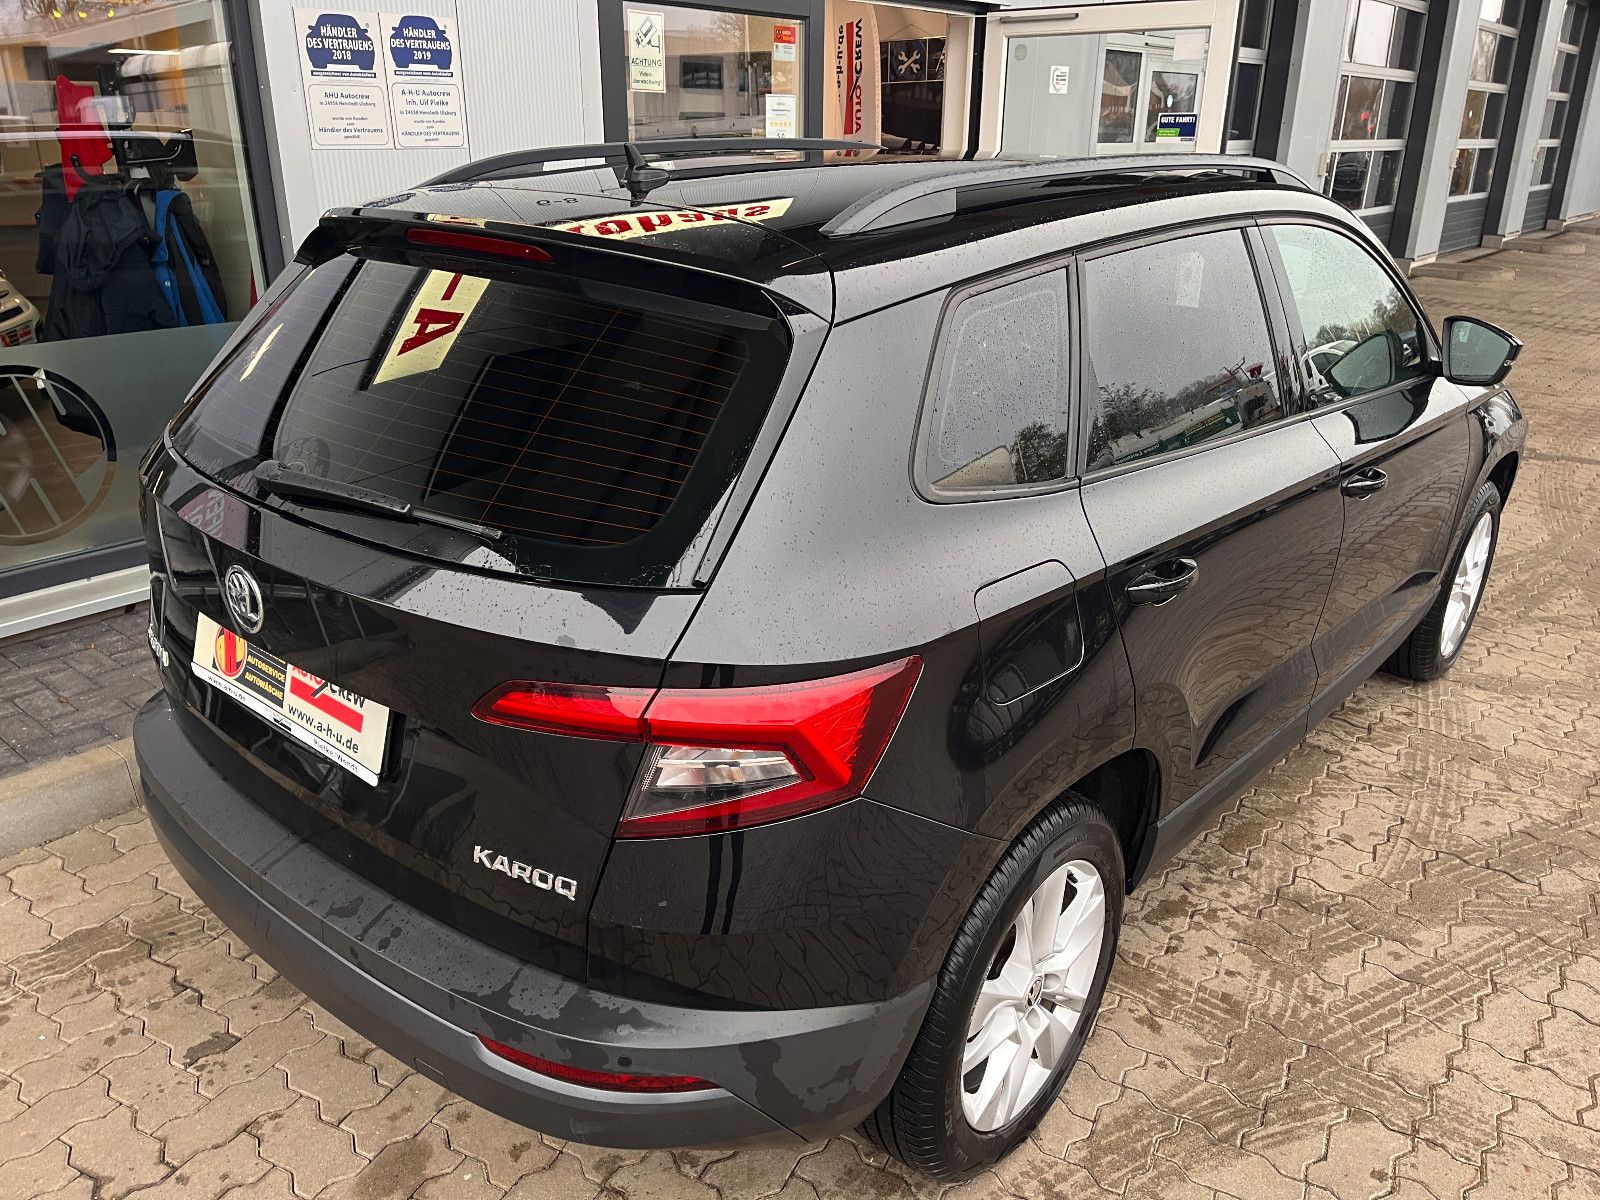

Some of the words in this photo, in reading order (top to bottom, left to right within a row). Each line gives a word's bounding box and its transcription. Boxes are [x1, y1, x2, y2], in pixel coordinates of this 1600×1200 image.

[320, 24, 358, 39] HÄNDLER
[403, 27, 437, 39] HÄNDLER
[306, 37, 323, 49] DES
[322, 38, 374, 51] VERTRAUENS
[391, 38, 405, 48] DES
[405, 40, 451, 51] VERTRAUENS
[332, 50, 352, 60] 2018
[413, 51, 431, 61] 2019
[631, 57, 663, 67] ACHTUNG
[405, 98, 418, 106] Inh.
[1160, 116, 1176, 124] GUTE
[1175, 116, 1196, 124] FAHRT!
[246, 654, 287, 683] AUTOSERVICE
[244, 671, 284, 701] AUTOWÄSCHE
[287, 703, 360, 755] www.a-h-u.de
[472, 845, 579, 902] KAROQ
